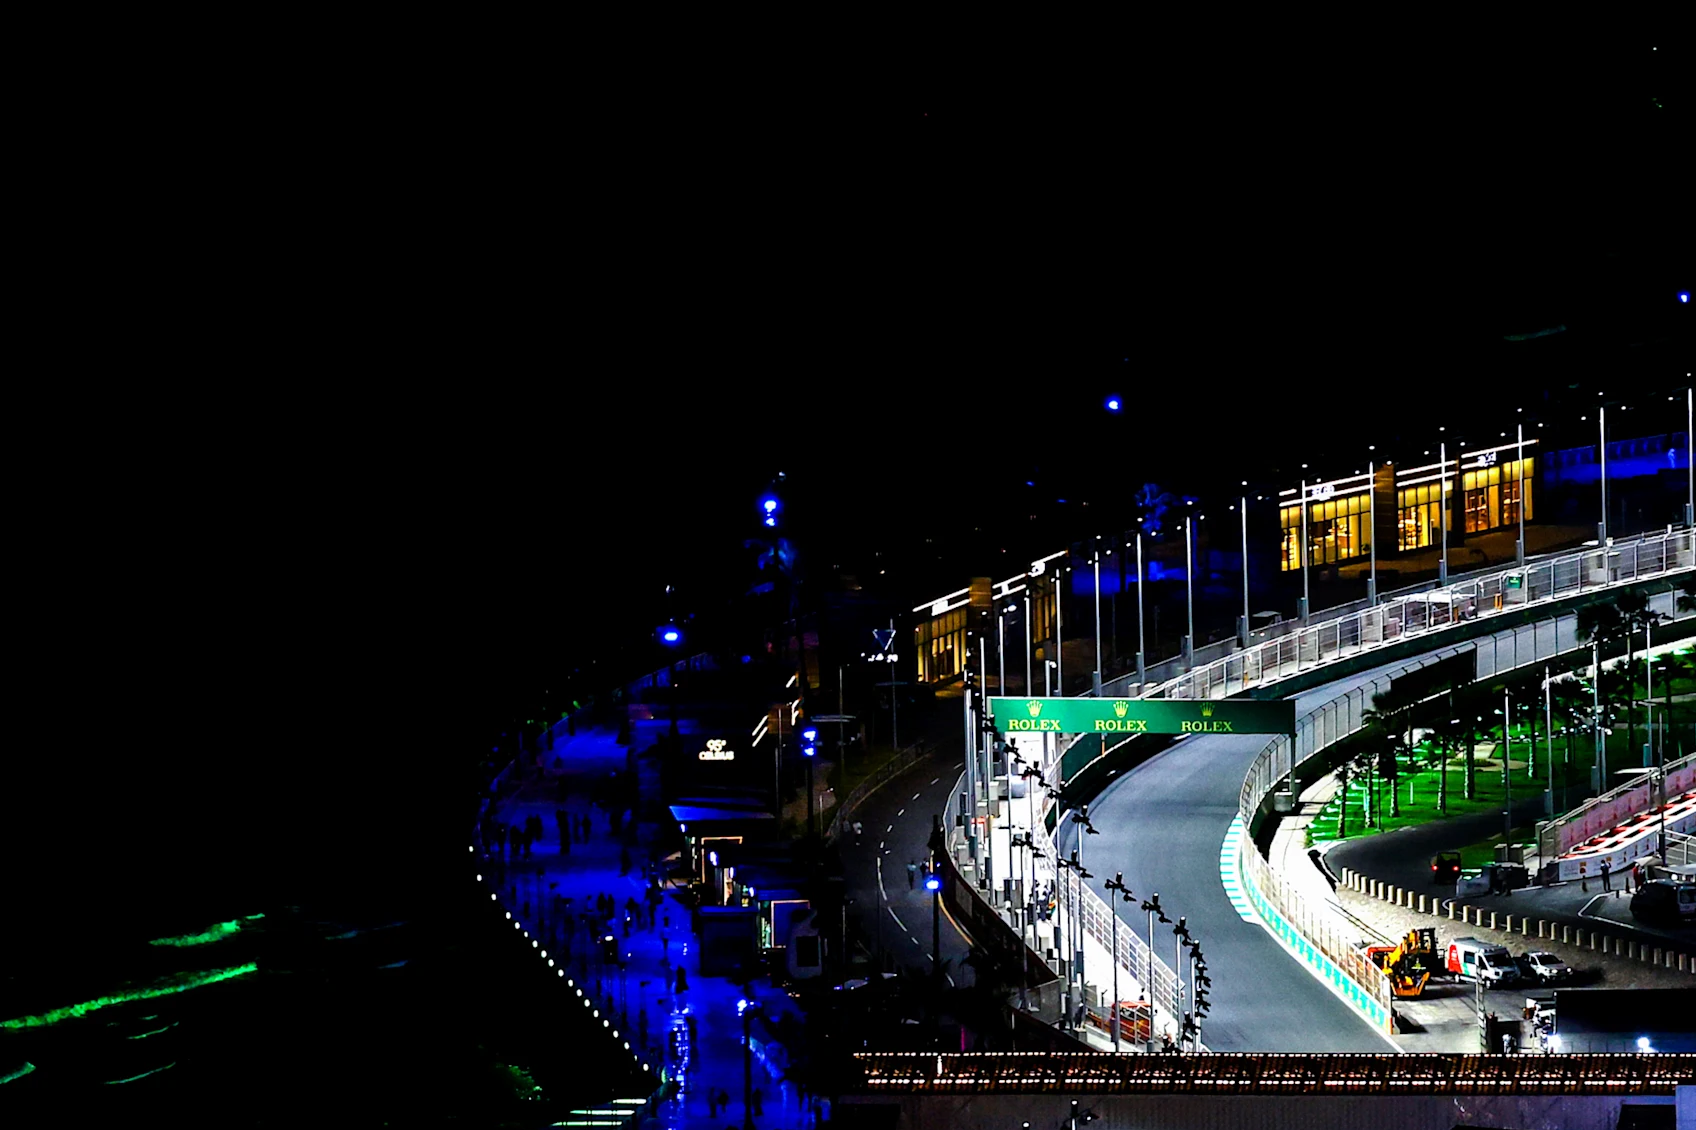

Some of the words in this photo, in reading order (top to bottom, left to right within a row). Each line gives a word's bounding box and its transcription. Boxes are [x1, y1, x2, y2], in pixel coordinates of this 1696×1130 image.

[1008, 719, 1061, 731] ROLEX
[1094, 720, 1147, 732] ROLEX
[1181, 721, 1233, 732] ROLEX
